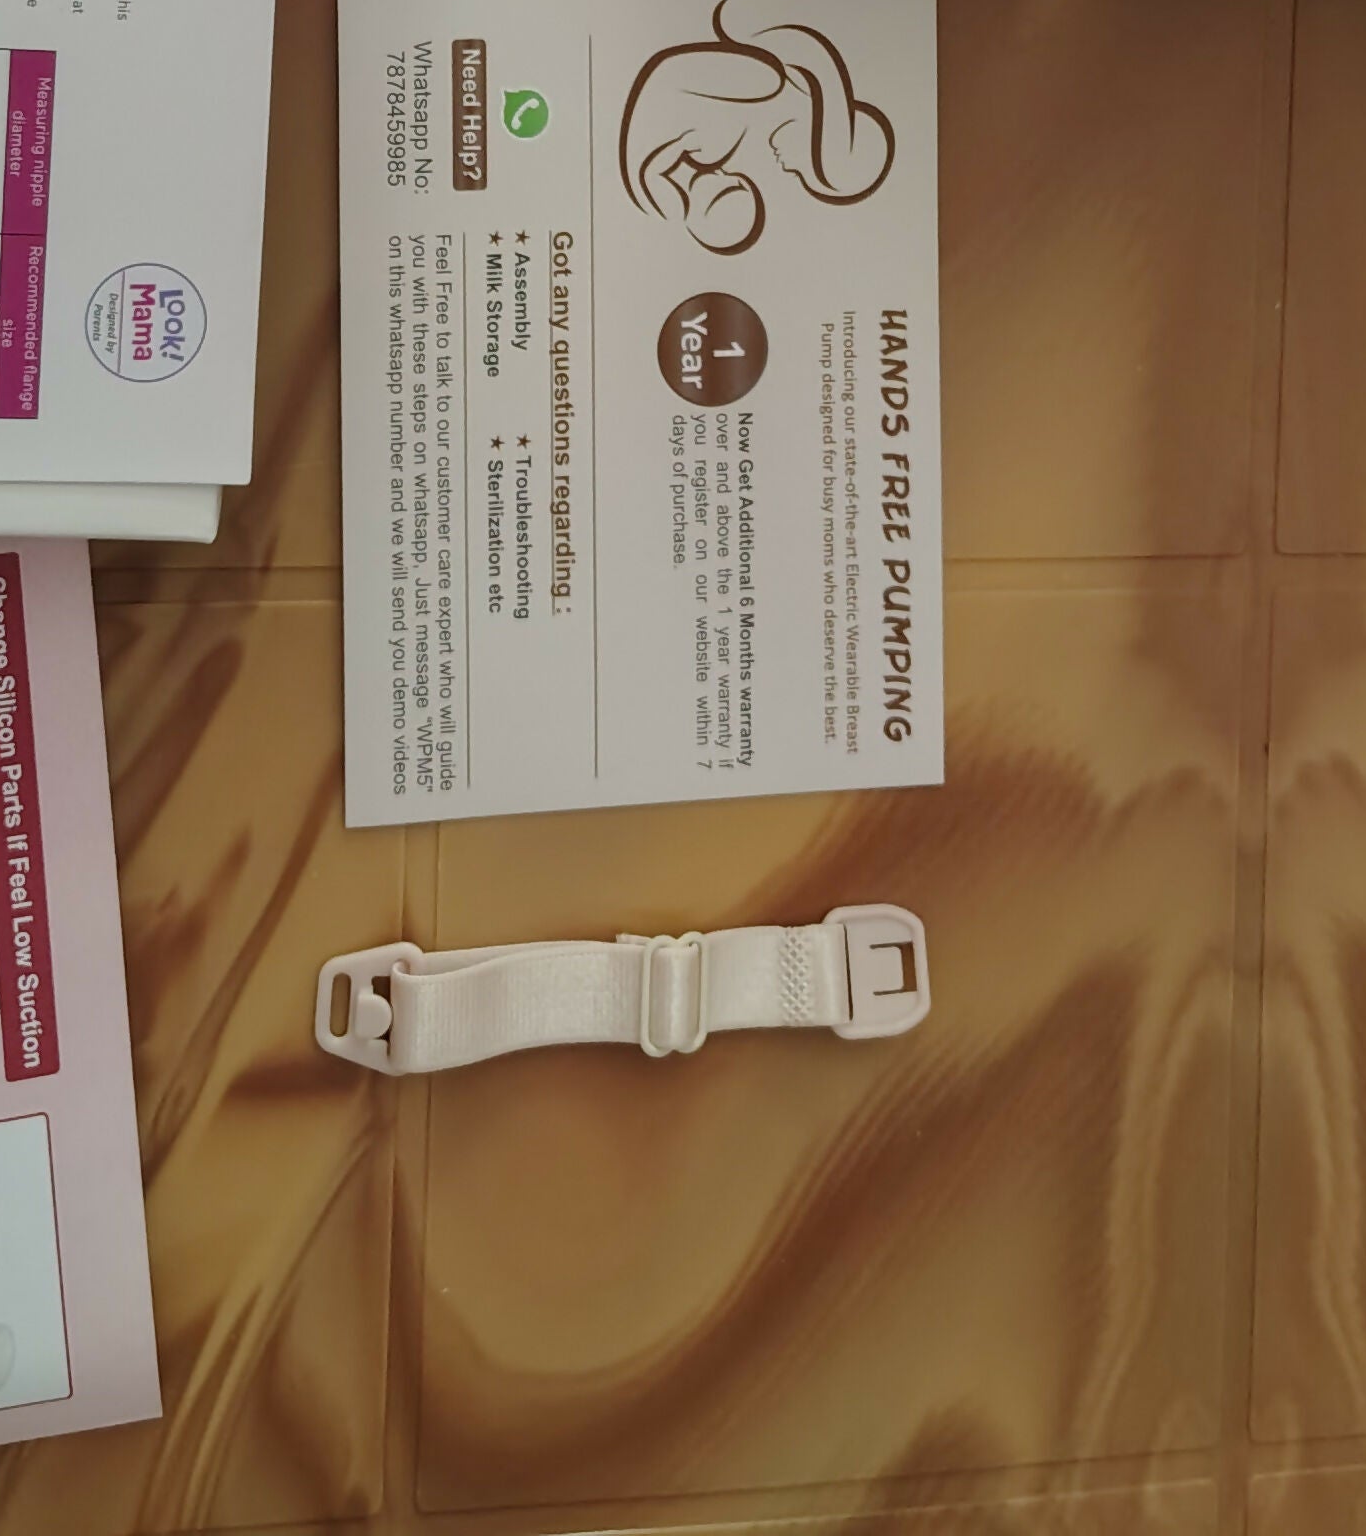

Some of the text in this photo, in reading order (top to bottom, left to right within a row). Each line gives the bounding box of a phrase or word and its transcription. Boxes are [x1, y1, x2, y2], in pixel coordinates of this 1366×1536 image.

[386, 50, 406, 186] 7878459985
[408, 40, 432, 150] Whatsapp
[457, 48, 481, 182] Need Help?
[9, 110, 25, 176] diameter
[29, 77, 52, 206] Measuring nipple
[552, 230, 573, 277] Got
[0, 318, 16, 347] size
[18, 245, 43, 410] Recommended flange
[92, 303, 103, 341] Parents
[104, 292, 119, 353] Designed by
[129, 283, 156, 360] Mama
[158, 288, 185, 362] Look!
[482, 253, 503, 377] Milk Storage
[510, 251, 531, 350] Assembly
[548, 285, 569, 331] any
[680, 311, 707, 389] Year
[712, 341, 745, 357] 1
[549, 340, 574, 466] questions
[487, 459, 504, 613] Sterilization etc
[512, 454, 533, 619] Troubleshooting
[550, 475, 575, 598] regarding
[878, 309, 911, 742] HANDS FREE PUMPING
[735, 412, 755, 766] Now Get Additional 6 Months warranty
[0, 763, 23, 828] Parts
[5, 833, 28, 850] If
[7, 856, 33, 909] Feel
[12, 914, 33, 967] Low
[16, 973, 43, 1068] Suction
